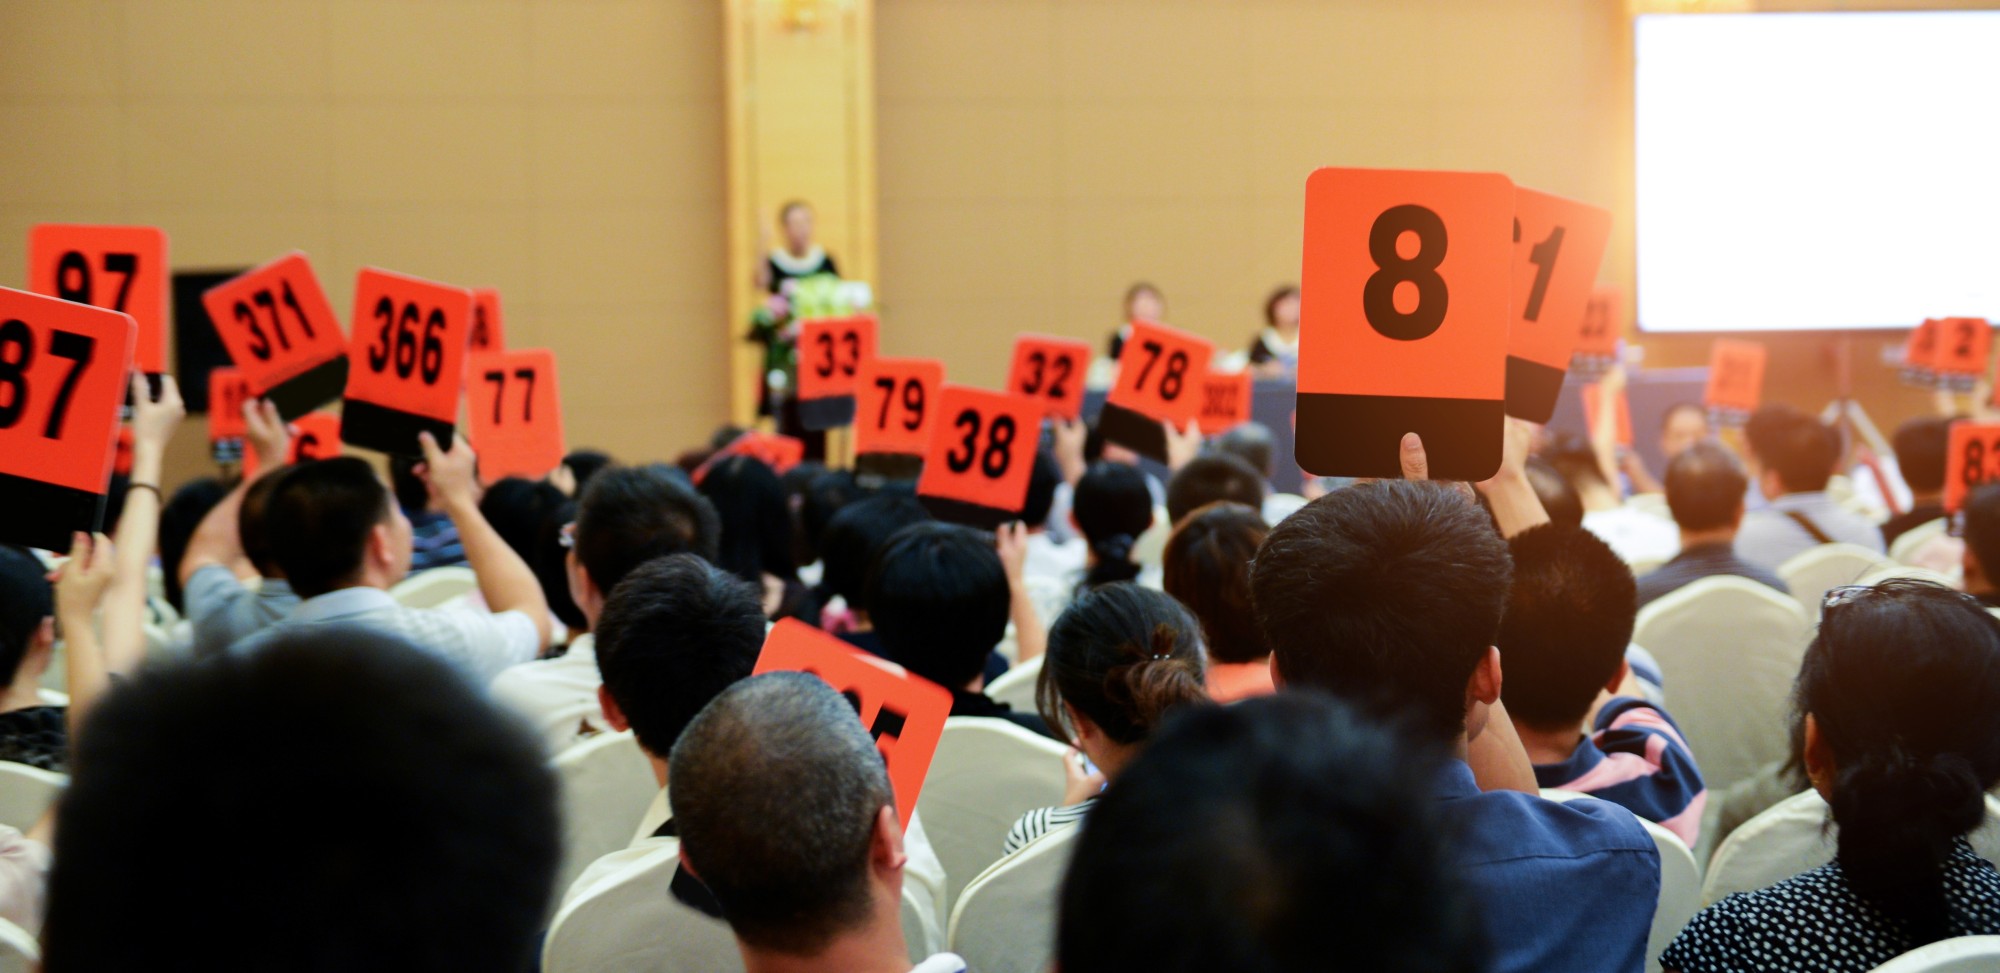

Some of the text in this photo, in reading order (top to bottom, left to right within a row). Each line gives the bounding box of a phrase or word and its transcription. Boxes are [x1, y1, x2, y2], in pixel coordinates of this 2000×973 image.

[57, 251, 138, 312] 97
[1363, 204, 1448, 341] 8
[1512, 216, 1565, 322] 1
[233, 278, 315, 361] 371
[369, 295, 446, 386] 366
[0, 319, 97, 440] 87
[816, 331, 859, 378] 33
[1022, 351, 1073, 398] 32
[1135, 341, 1189, 401] 78
[484, 369, 536, 425] 77
[875, 377, 925, 431] 79
[947, 408, 1016, 479] 38
